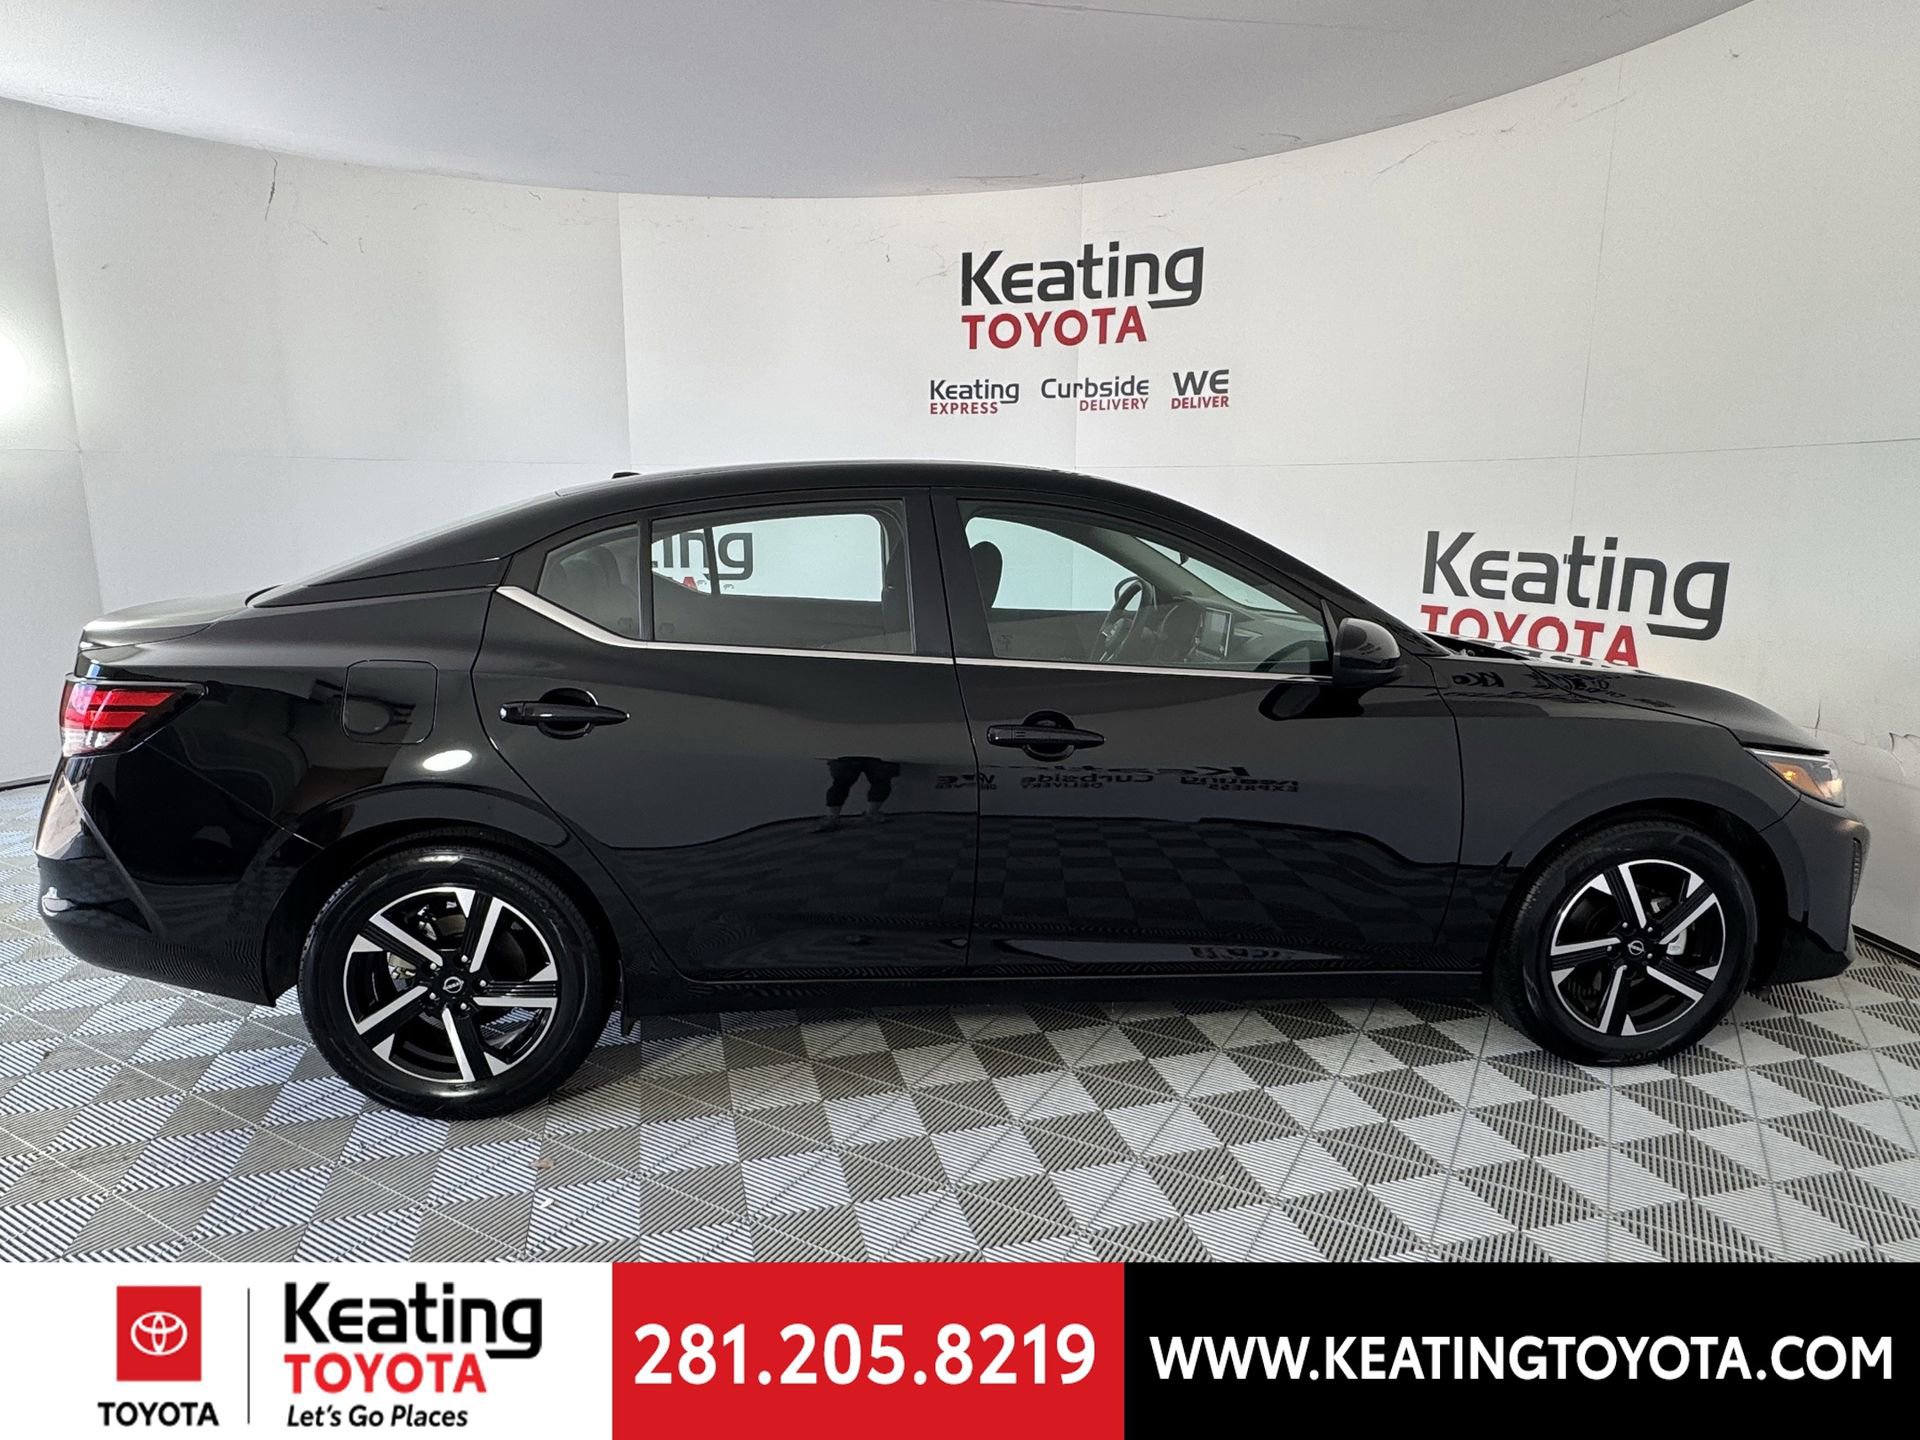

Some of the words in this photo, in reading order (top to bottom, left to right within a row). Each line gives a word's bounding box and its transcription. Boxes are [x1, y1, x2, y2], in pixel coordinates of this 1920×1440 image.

[962, 241, 1204, 309] Keating
[962, 306, 1147, 350] TOYOTA
[930, 379, 1019, 404] Keating
[1041, 375, 1149, 399] Curbside
[1173, 369, 1229, 396] WE
[930, 401, 998, 415] EXPRESS
[1079, 398, 1149, 411] DELIVERY
[1171, 395, 1229, 410] DELIVER
[1422, 531, 1730, 641] Keating
[1421, 604, 1639, 668] TOYOTA
